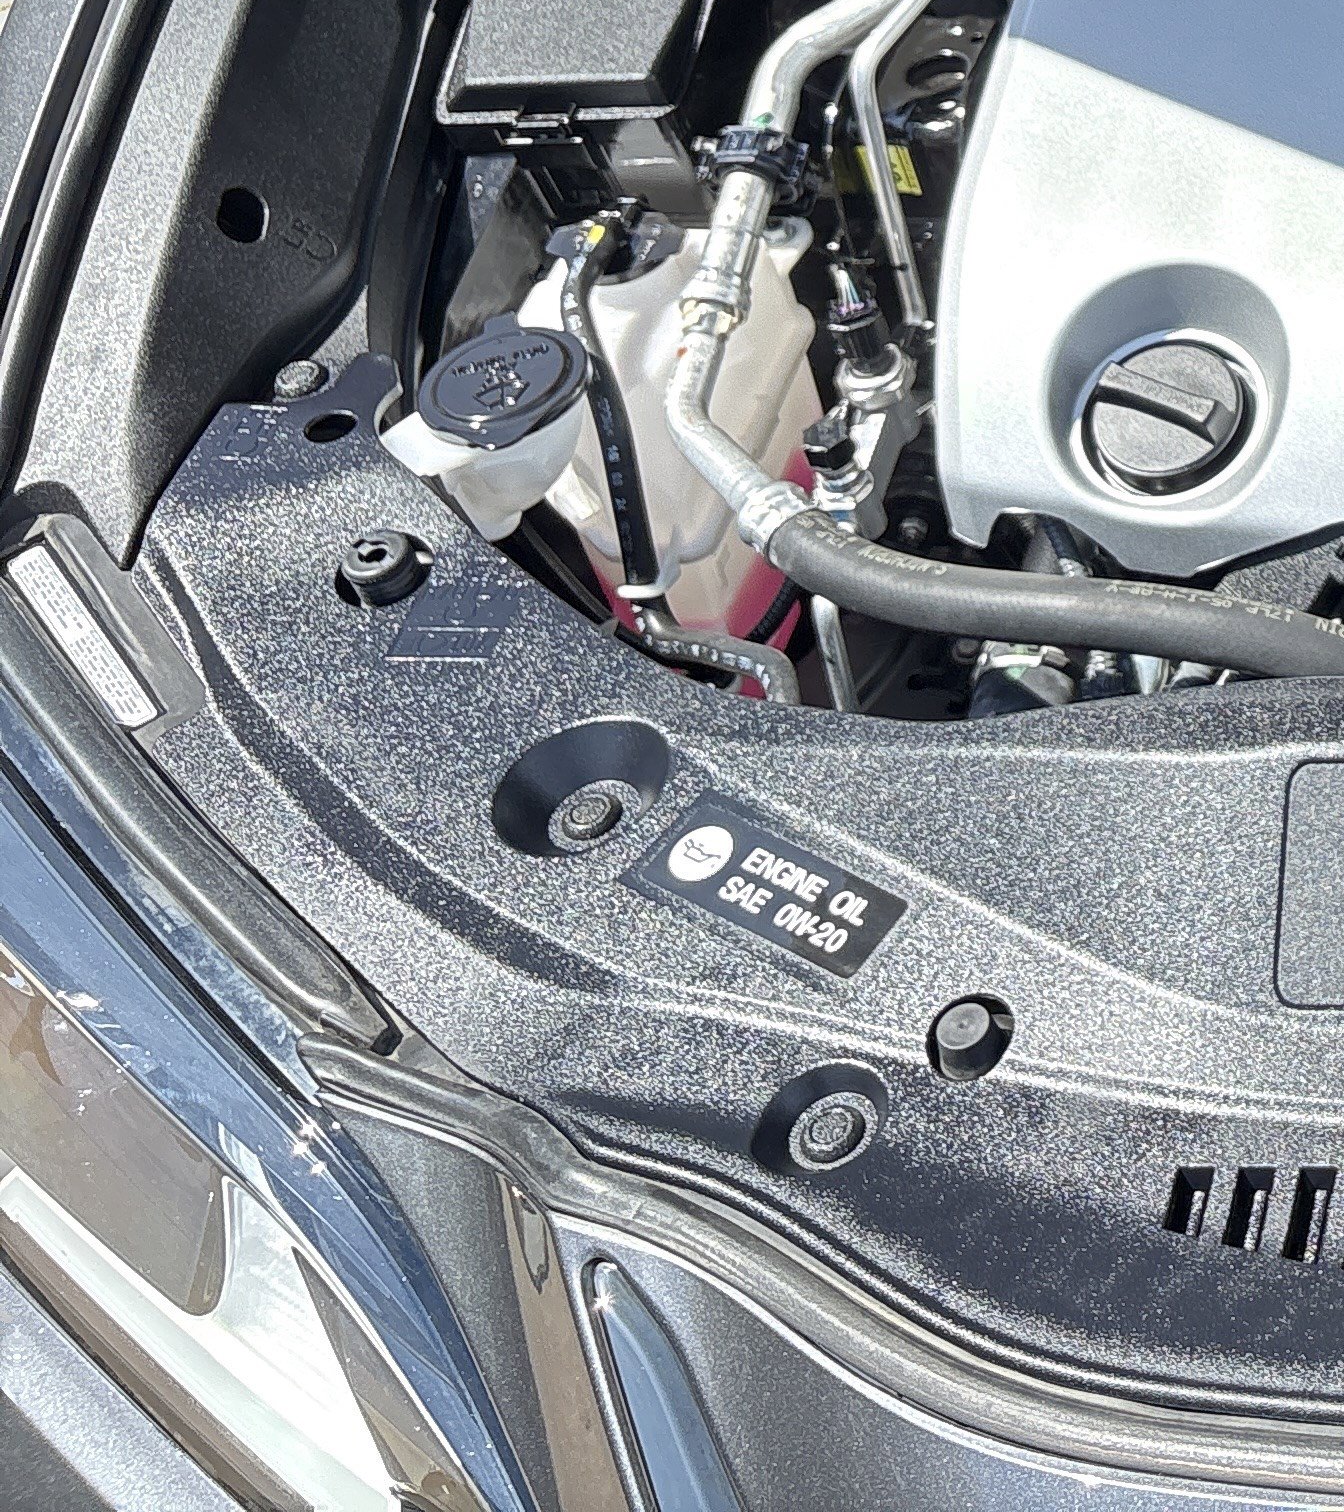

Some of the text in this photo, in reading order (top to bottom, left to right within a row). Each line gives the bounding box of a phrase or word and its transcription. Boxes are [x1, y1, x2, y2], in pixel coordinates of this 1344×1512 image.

[717, 876, 849, 954] SAE 0W-20
[740, 847, 869, 927] ENGINE OIL
